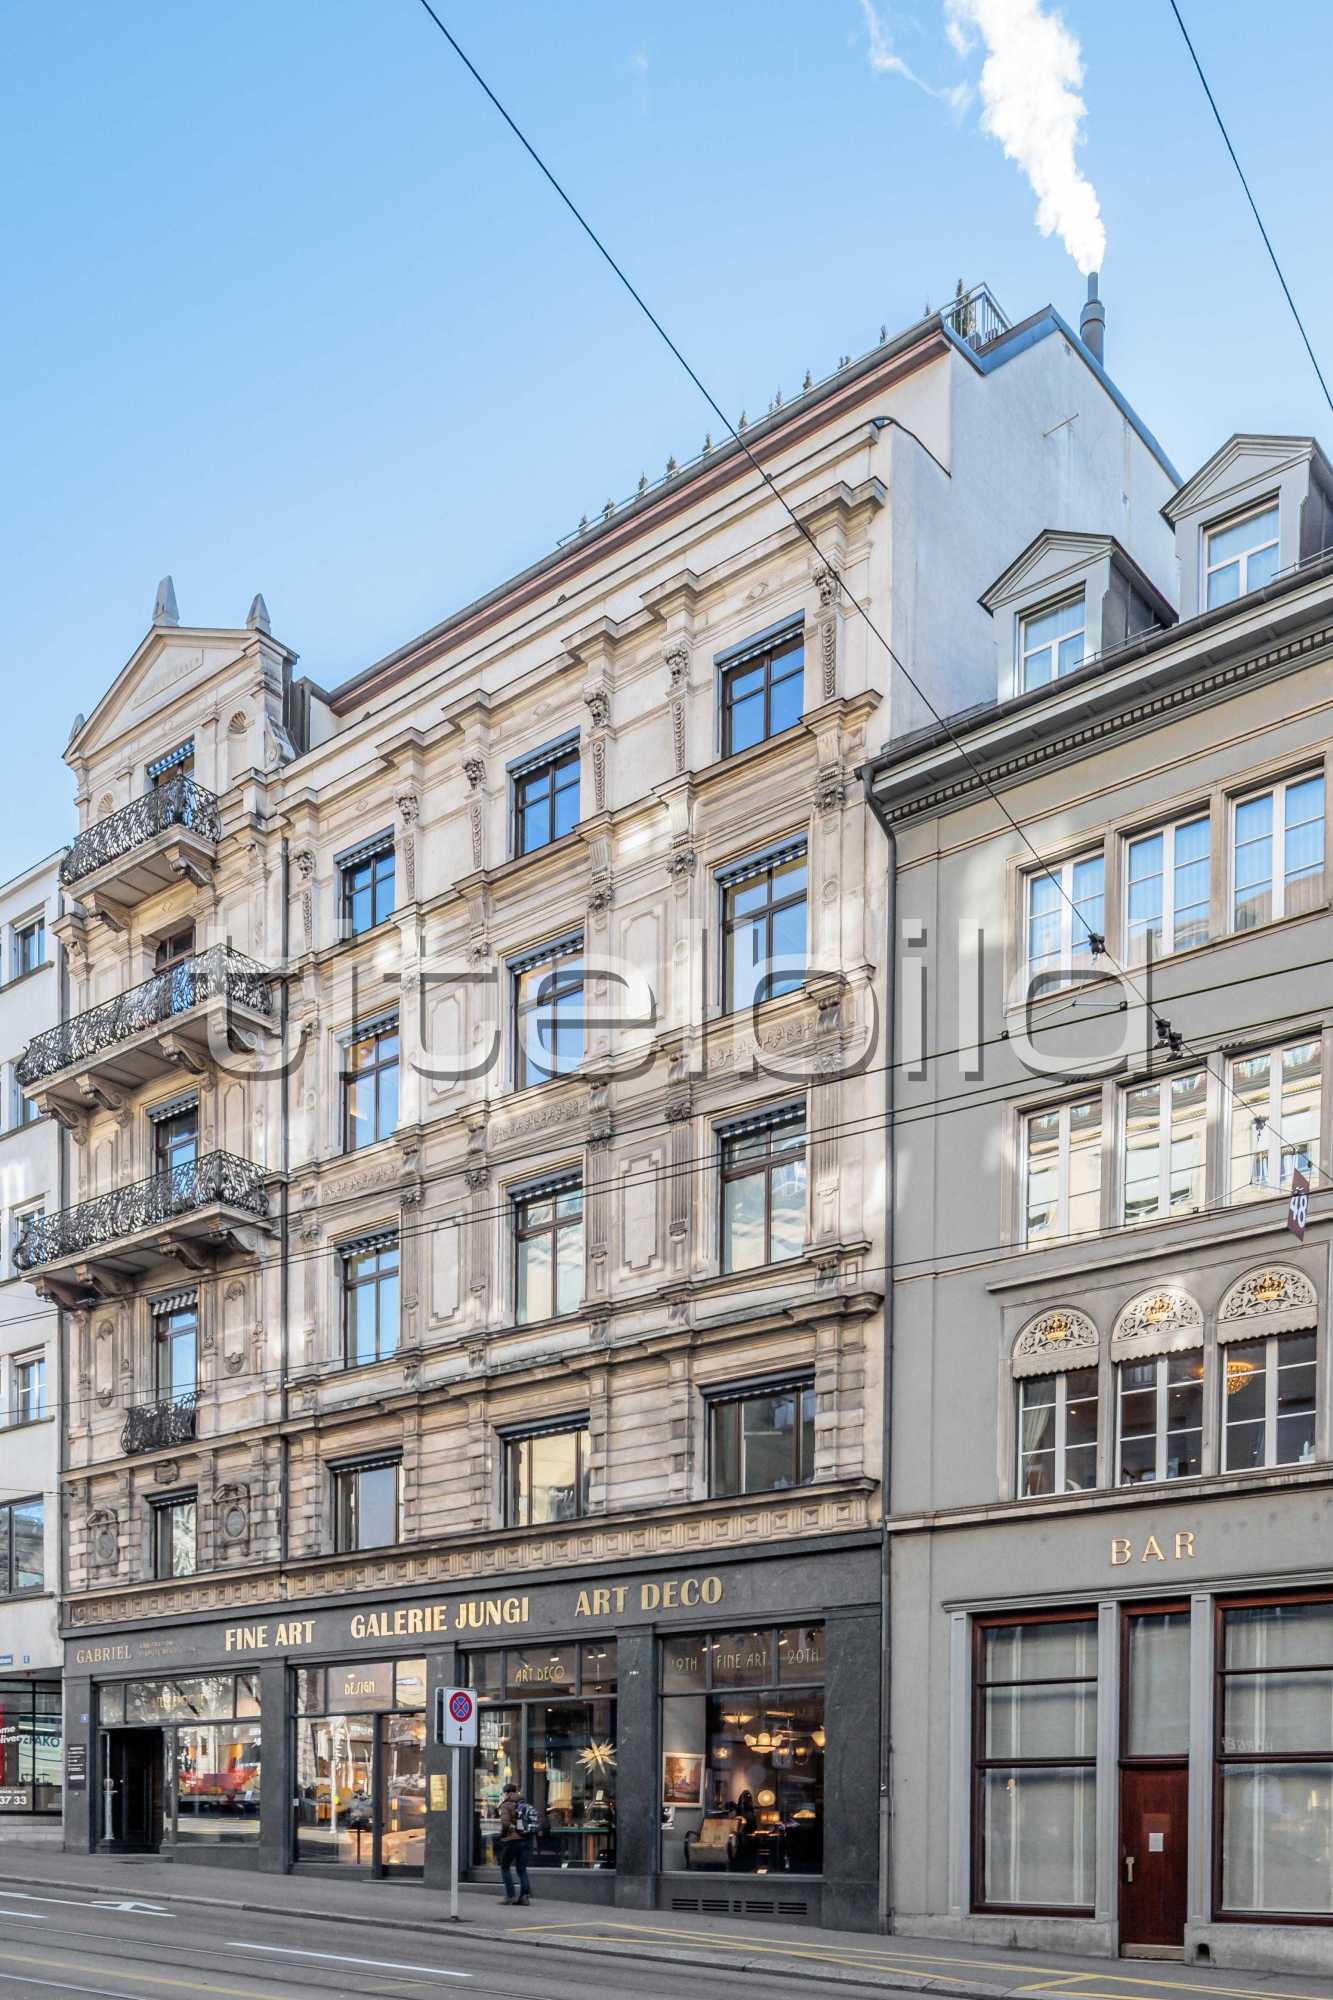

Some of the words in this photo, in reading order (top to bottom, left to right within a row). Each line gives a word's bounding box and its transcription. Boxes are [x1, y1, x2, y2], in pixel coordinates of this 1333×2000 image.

[1111, 1531, 1195, 1566] BAR
[575, 1586, 629, 1617] ART
[641, 1576, 722, 1610] DECO
[350, 1605, 448, 1638] GALERIE
[455, 1597, 529, 1629] JUNGI
[225, 1625, 269, 1651] FINE
[275, 1620, 316, 1646] ART
[76, 1645, 132, 1664] GABRIEL
[716, 1654, 742, 1670] FINE
[746, 1651, 767, 1668] ART
[787, 1648, 819, 1665] 20TH
[515, 1666, 534, 1683] ART
[537, 1664, 565, 1681] DECO
[344, 1681, 375, 1695] DESIGN
[13, 1796, 27, 1805] 33
